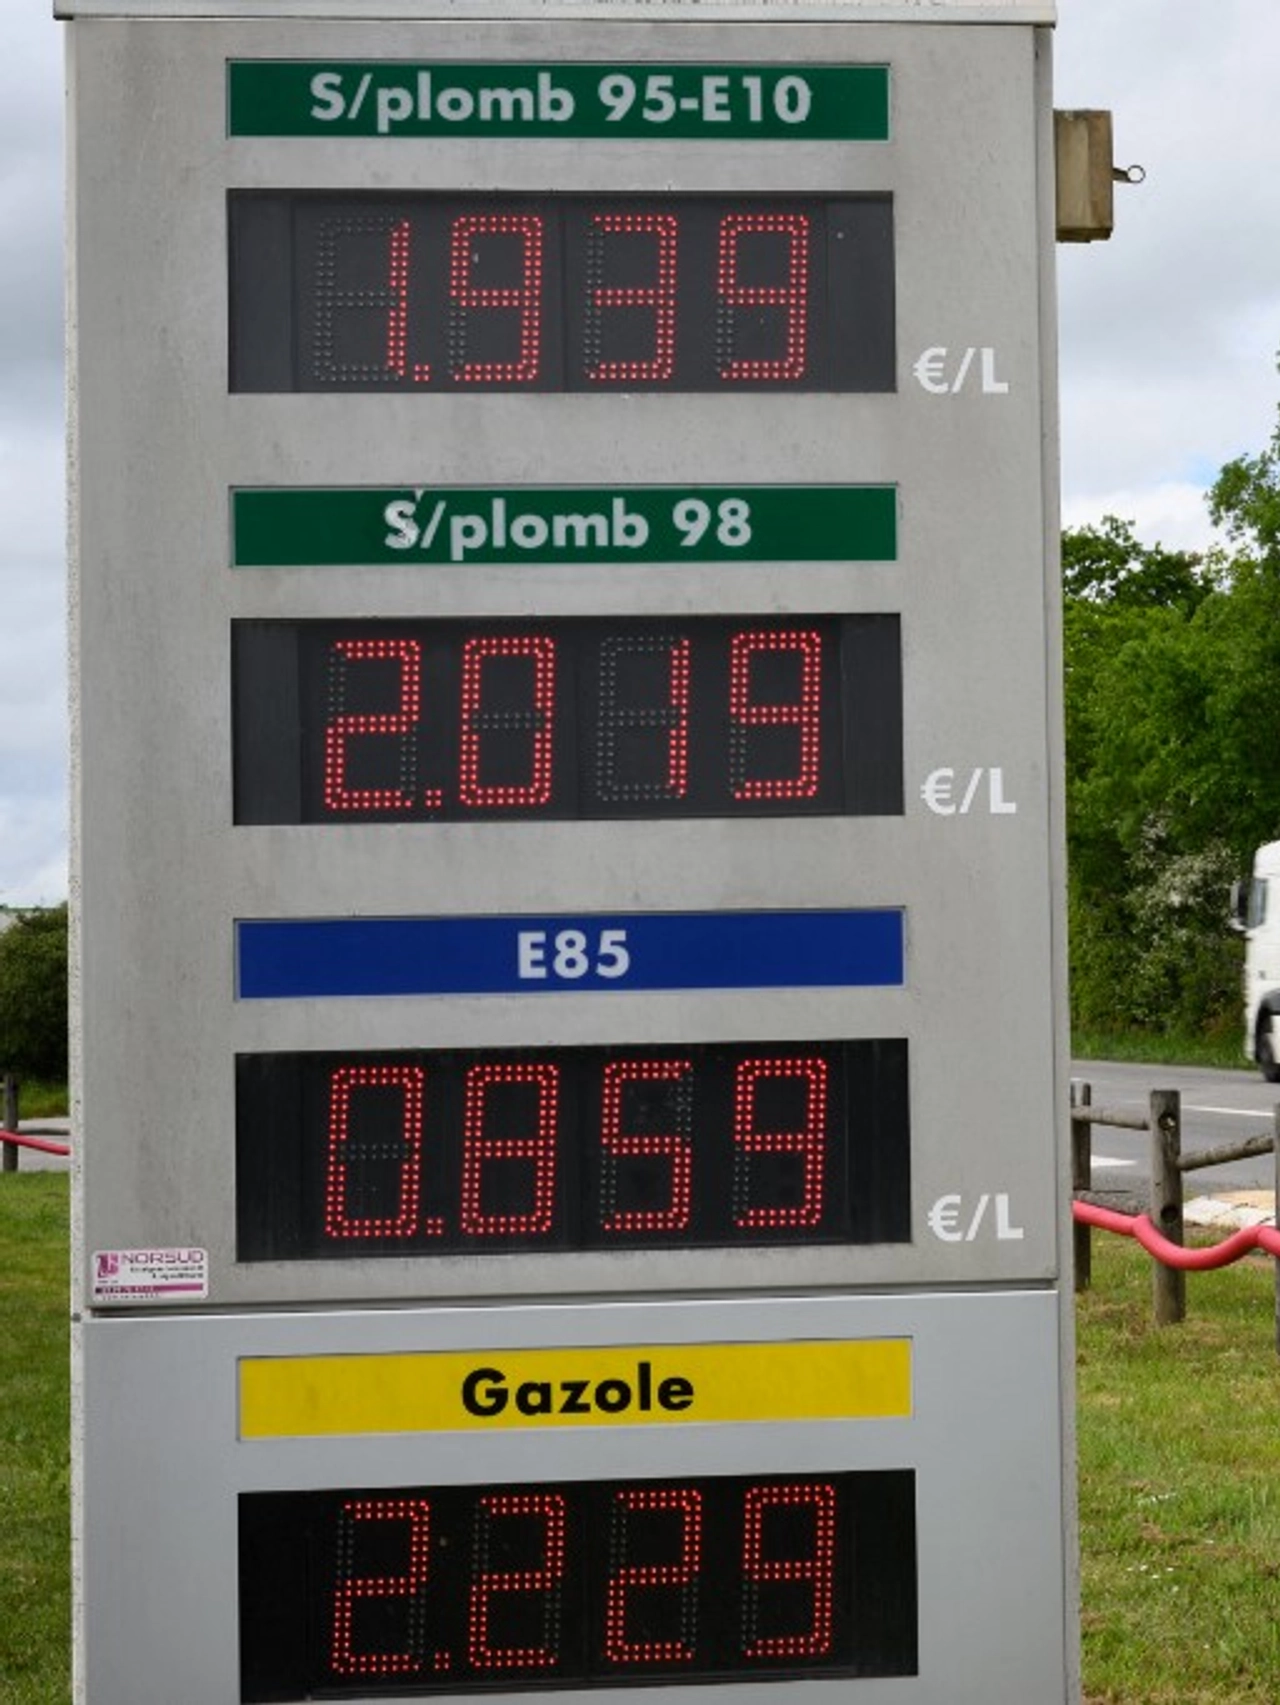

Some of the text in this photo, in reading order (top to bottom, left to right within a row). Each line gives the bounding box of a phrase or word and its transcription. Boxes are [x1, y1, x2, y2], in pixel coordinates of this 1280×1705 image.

[309, 73, 812, 131] S/plomb 95-E10
[387, 214, 809, 382] 1.939
[912, 347, 1009, 394] €/L
[383, 499, 752, 560] S/plomb 98
[324, 631, 822, 810] 2.019
[920, 767, 1018, 816] €/L
[517, 930, 630, 978] E85
[325, 1058, 828, 1238] 0.859
[926, 1193, 1025, 1242] €/L
[121, 1250, 204, 1264] NORSUD
[462, 1361, 695, 1417] Gazole
[332, 1484, 836, 1673] 2.229
